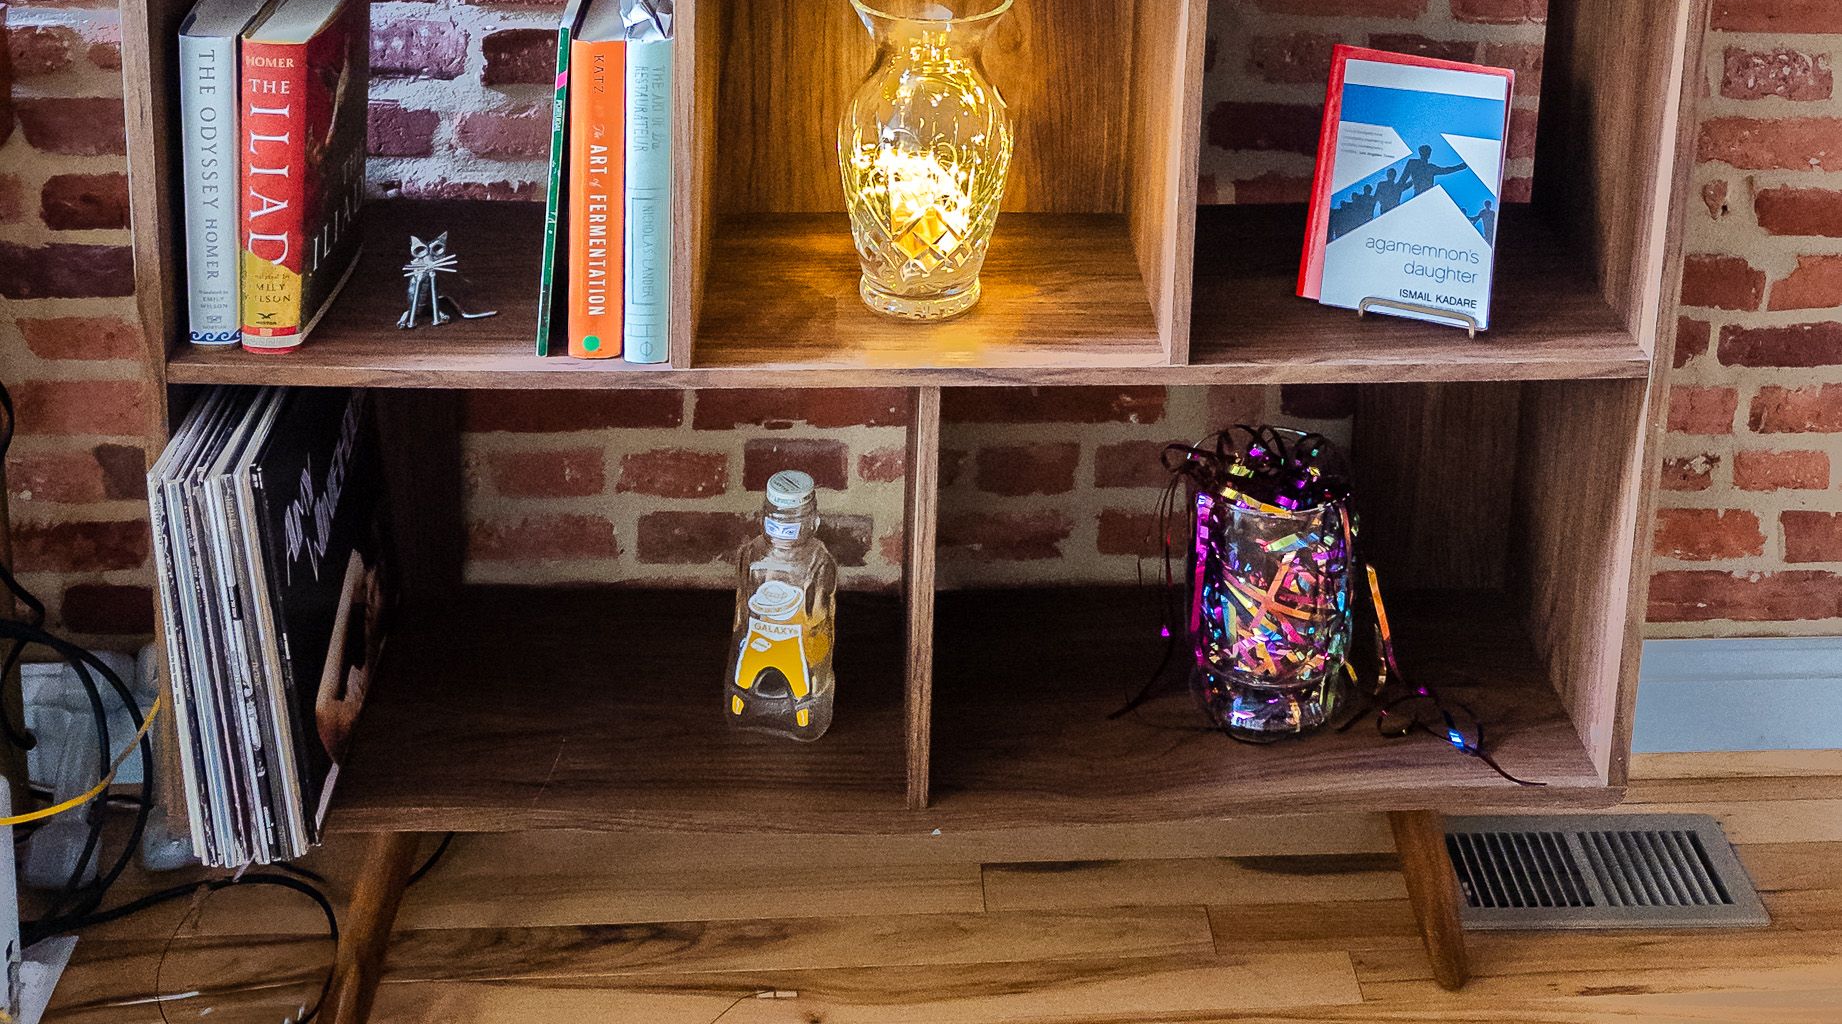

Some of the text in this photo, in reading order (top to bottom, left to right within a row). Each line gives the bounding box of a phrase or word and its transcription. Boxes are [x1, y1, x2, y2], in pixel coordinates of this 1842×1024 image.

[245, 56, 294, 68] HOMER
[593, 54, 605, 94] KATZ
[249, 78, 290, 94] THE
[652, 64, 665, 89] THE
[633, 65, 649, 152] RESTAURATEUR
[652, 92, 665, 111] ART
[199, 49, 220, 280] THE ODYSSEY HOMER
[589, 144, 608, 174] ART
[247, 102, 290, 266] ILIAD
[313, 174, 364, 272] ILIAD
[588, 194, 607, 316] FERMENTATION
[642, 206, 655, 297] NICHOLAS LANDER
[1365, 236, 1480, 265] agamemnon's
[1403, 260, 1479, 284] daughter
[245, 295, 291, 303] ILSON
[252, 283, 286, 292] MILY
[1399, 288, 1432, 302] ISMAIL
[1435, 294, 1478, 309] KADARE
[754, 622, 794, 635] GALAXY
